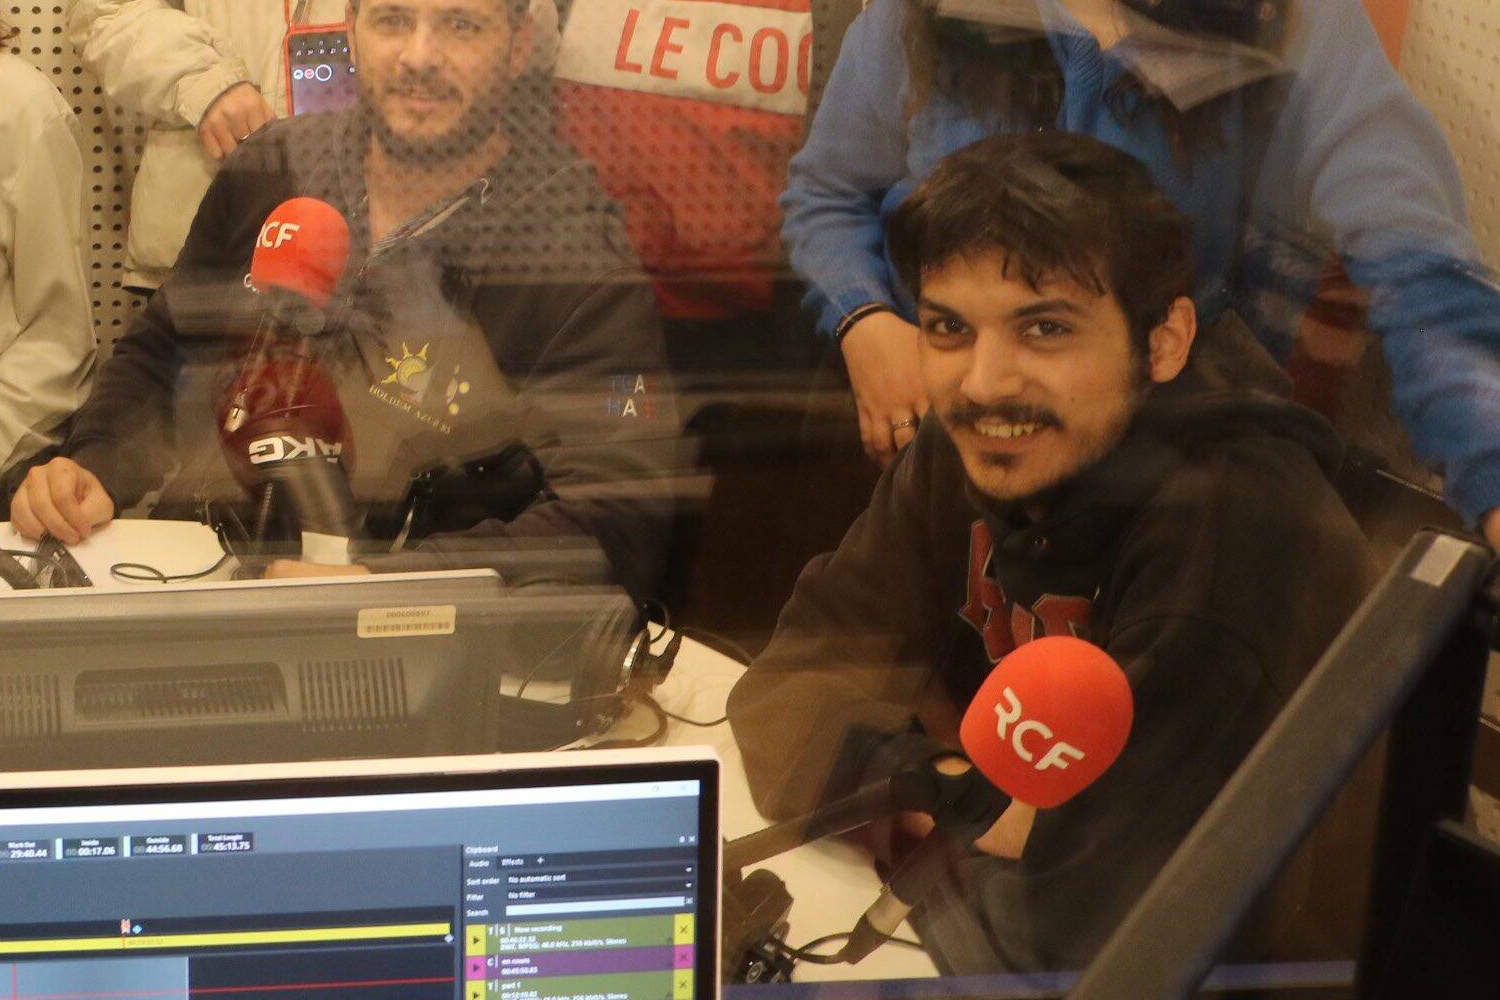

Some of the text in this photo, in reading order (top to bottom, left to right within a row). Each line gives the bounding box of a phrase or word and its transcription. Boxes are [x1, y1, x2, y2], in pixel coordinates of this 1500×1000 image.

[614, 8, 690, 81] LE
[255, 220, 301, 248] CF
[993, 685, 1086, 771] RCF
